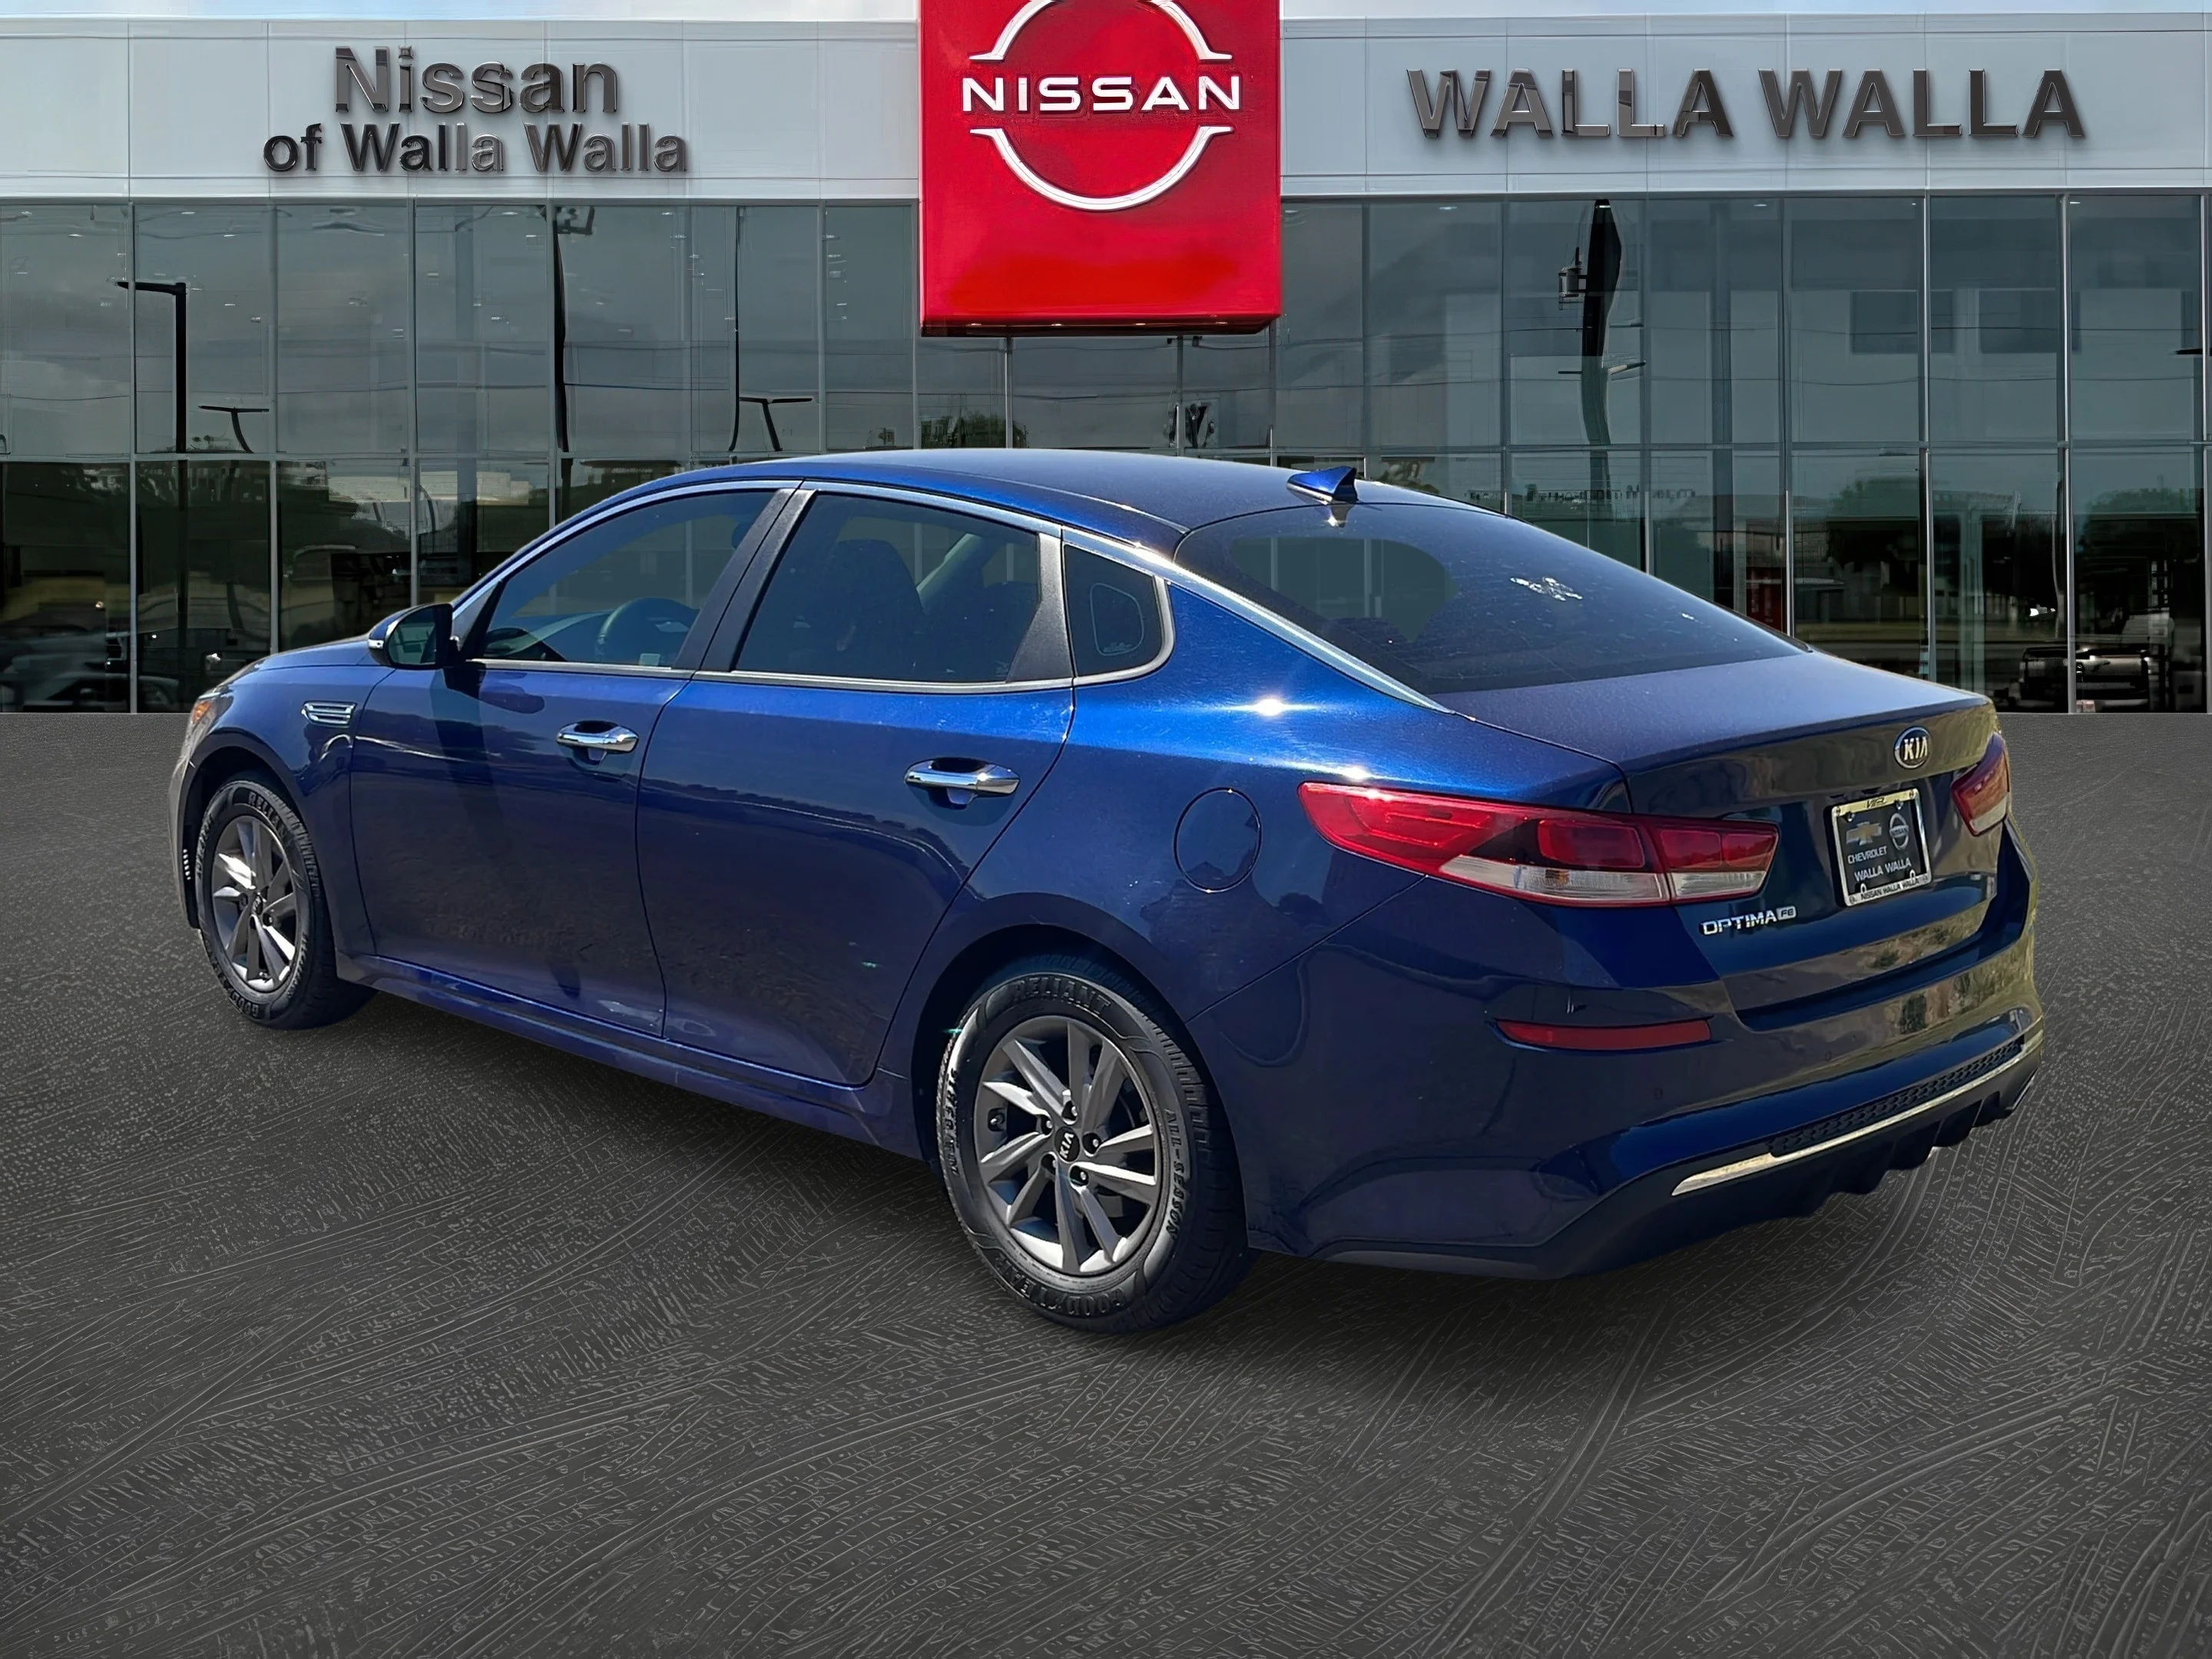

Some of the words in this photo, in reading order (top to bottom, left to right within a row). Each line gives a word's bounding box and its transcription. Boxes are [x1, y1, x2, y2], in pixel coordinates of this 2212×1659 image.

[335, 45, 618, 114] Nissan
[962, 75, 1240, 111] NISSAN
[1406, 68, 1734, 138] WALLA
[1757, 68, 2085, 138] WALLA
[263, 122, 323, 172] of
[339, 122, 505, 172] Walla
[523, 122, 687, 172] Walla
[1904, 736, 1928, 760] KIA
[1847, 846, 1887, 865] CHEVROLET
[1854, 865, 1883, 882] WALLA
[1885, 857, 1912, 873] WALLA
[1860, 889, 1883, 901] NISSAN
[1882, 882, 1901, 894] WALLA
[1702, 910, 1777, 935] OPTIMA
